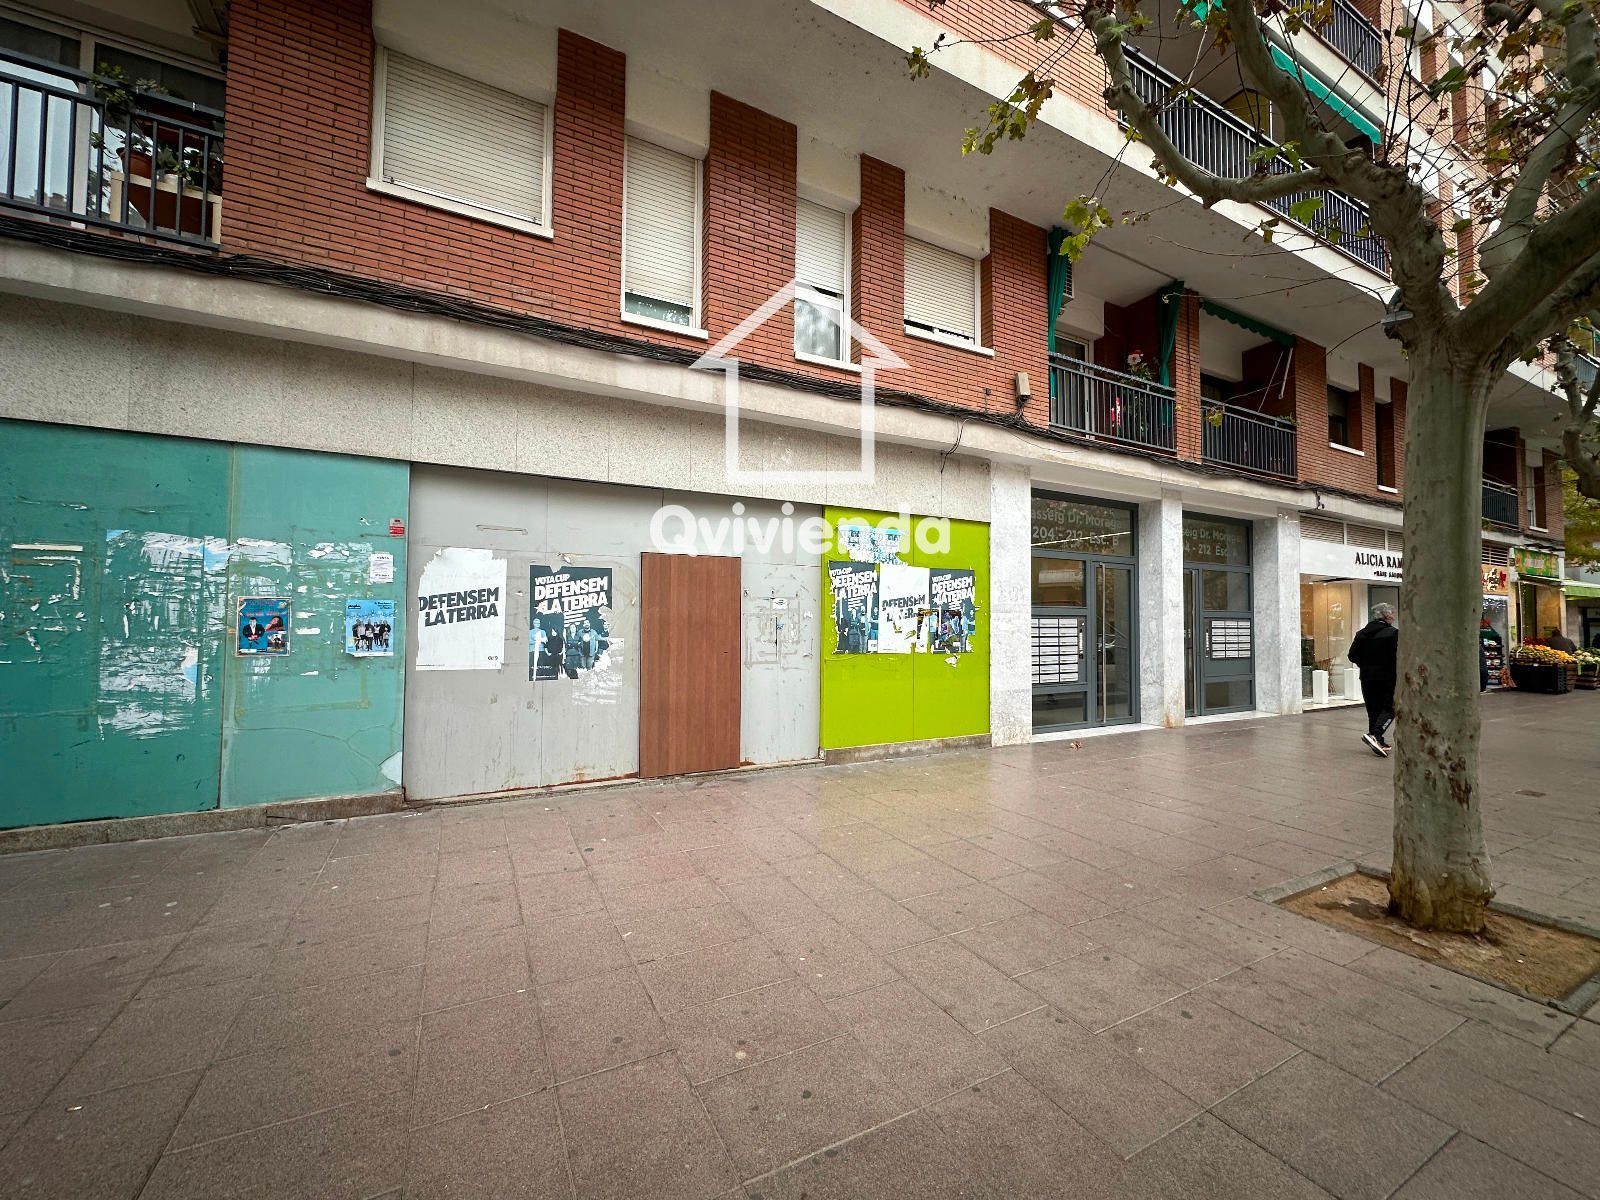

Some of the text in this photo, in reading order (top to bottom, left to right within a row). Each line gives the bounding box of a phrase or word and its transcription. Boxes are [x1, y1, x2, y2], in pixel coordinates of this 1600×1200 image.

[1031, 508, 1064, 524] asseig
[1068, 510, 1083, 524] Dr.
[1032, 525, 1055, 539] 204
[1089, 532, 1109, 545] Esc.
[1182, 527, 1198, 540] seig
[1198, 543, 1211, 555] 212
[1355, 551, 1403, 568] ALICIA RAM
[534, 573, 570, 585] VOTA CUP
[534, 575, 609, 601] DEFENSEM
[931, 575, 973, 594] DEFENSEM
[418, 587, 499, 611] DEFENSEM
[541, 591, 608, 615] LA TERRA
[425, 603, 499, 627] LA TERRA
